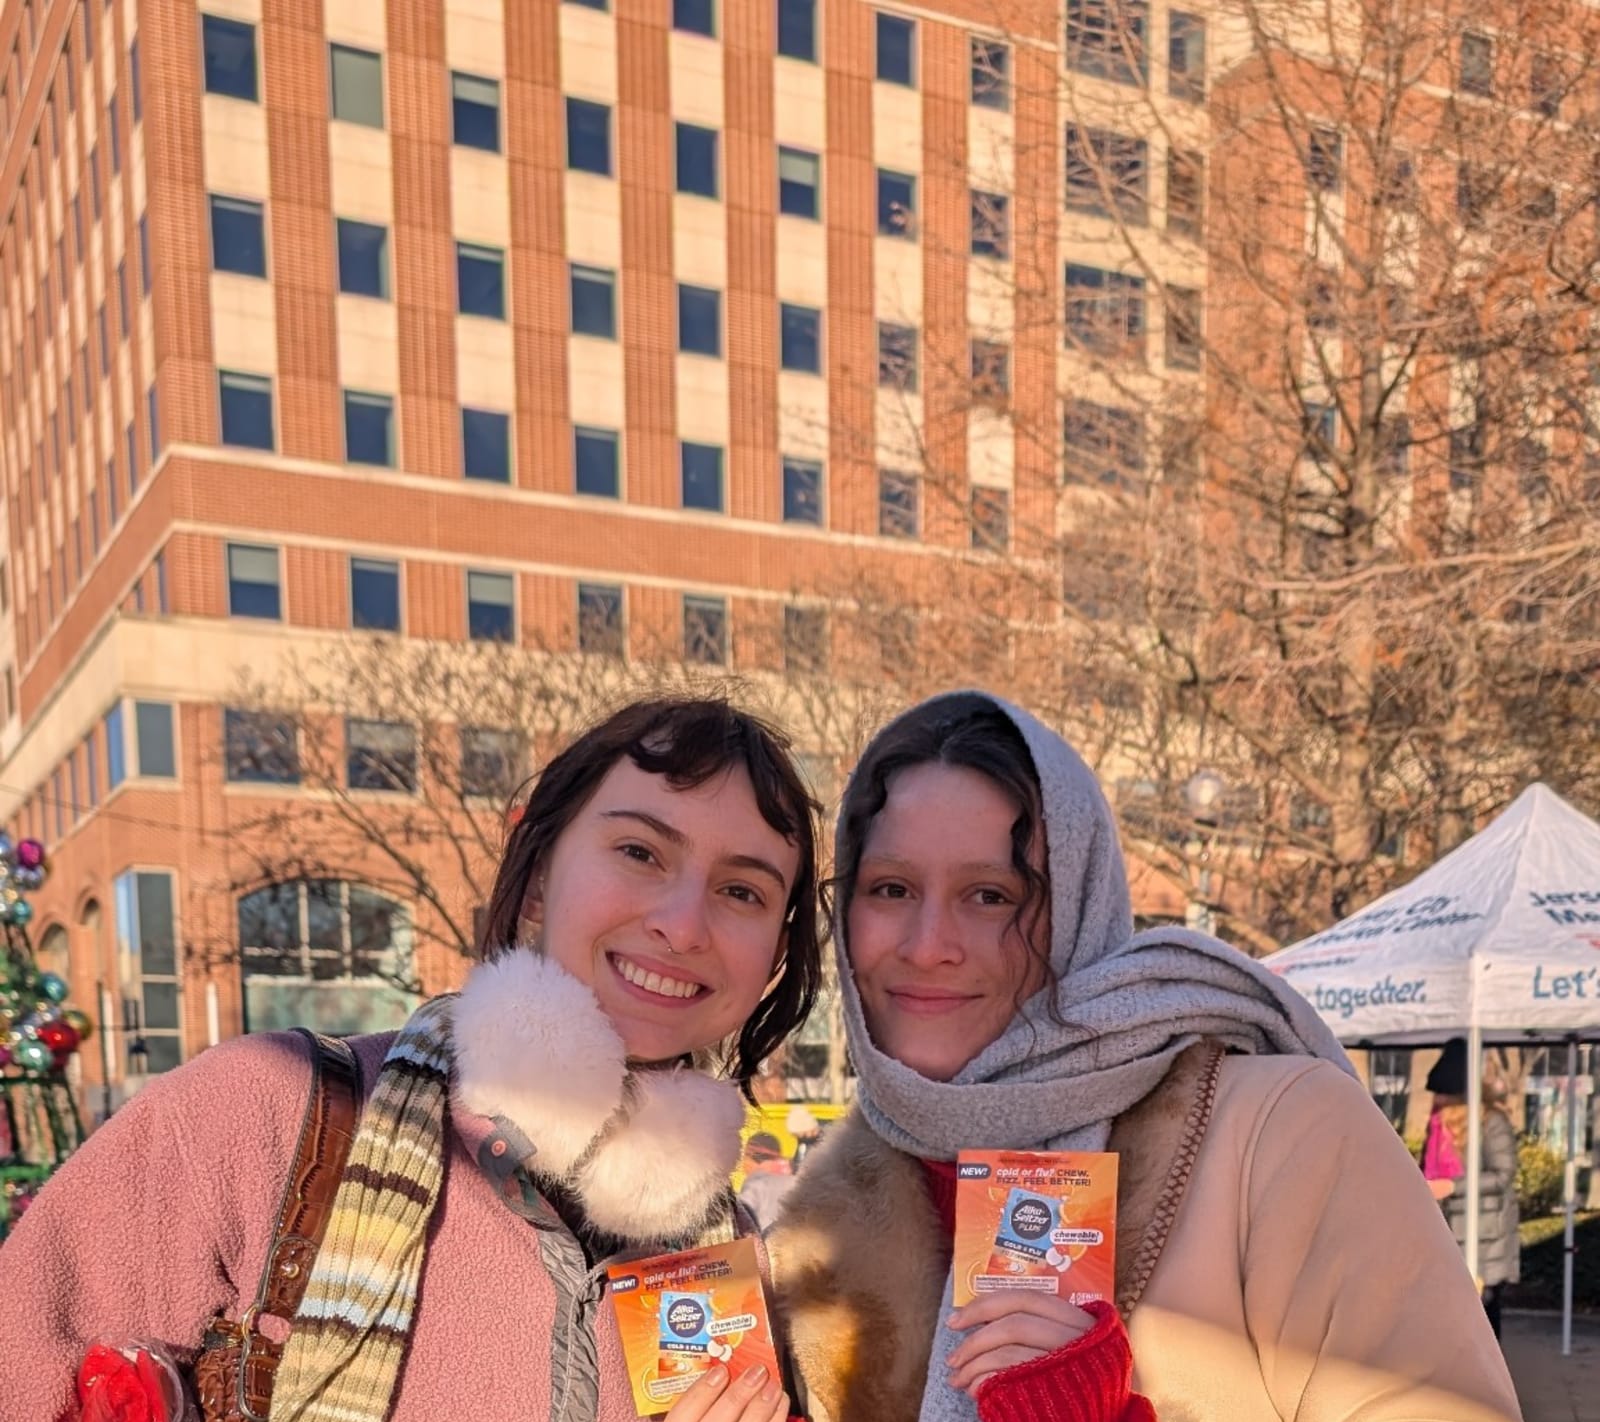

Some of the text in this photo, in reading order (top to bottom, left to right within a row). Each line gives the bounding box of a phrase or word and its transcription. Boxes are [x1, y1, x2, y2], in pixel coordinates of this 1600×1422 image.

[1529, 891, 1600, 906] Jers
[1315, 975, 1427, 1017] together.
[960, 1167, 988, 1176] NEW!
[996, 1168, 1019, 1177] cold
[1035, 1168, 1055, 1177] flu?
[1050, 1178, 1091, 1186] BETTER!
[1013, 1213, 1050, 1224] Seltzer
[1054, 1230, 1099, 1239] chewable!
[612, 1279, 636, 1290] NEW!
[644, 1273, 664, 1284] cold
[666, 1271, 677, 1279] or
[678, 1265, 697, 1278] flu?
[694, 1267, 733, 1281] BETTER!
[669, 1312, 702, 1323] Seltzer
[710, 1316, 752, 1330] chewable!
